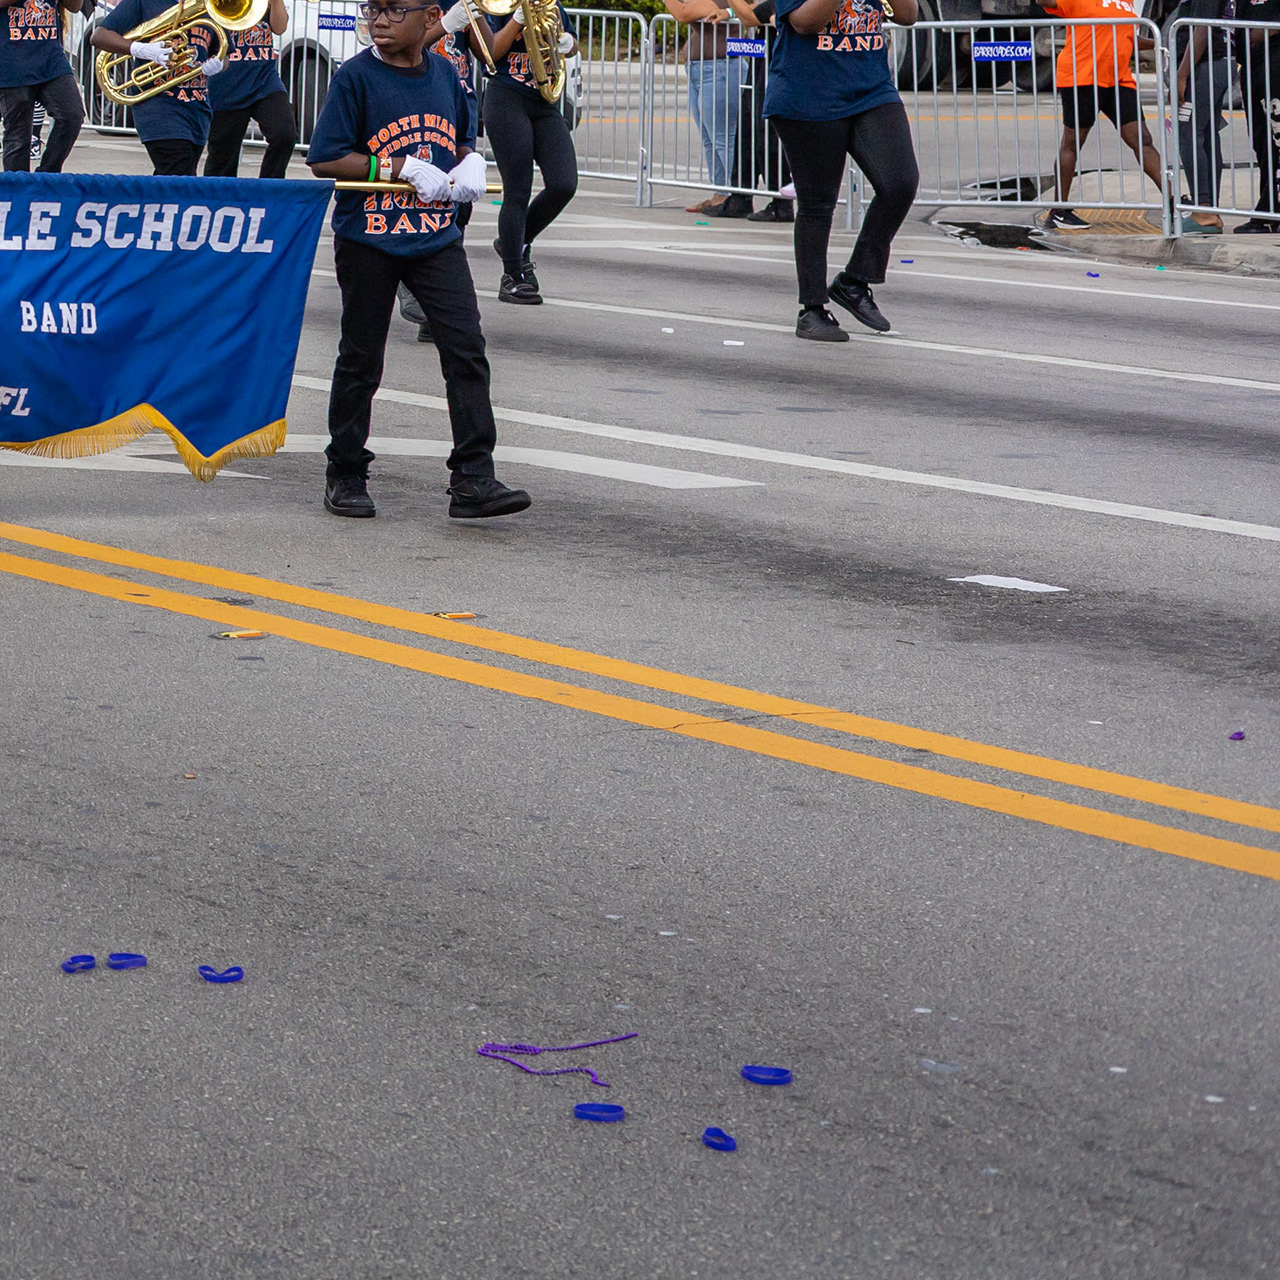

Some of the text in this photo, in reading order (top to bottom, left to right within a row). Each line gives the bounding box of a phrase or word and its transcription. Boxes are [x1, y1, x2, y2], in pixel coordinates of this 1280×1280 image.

[8, 6, 57, 28] TIGER
[229, 25, 273, 47] TIGER
[816, 35, 884, 51] BAND
[229, 47, 278, 62] BAN
[974, 45, 1032, 58] BARRICADES.COM
[367, 113, 457, 153] NORTH MIAM
[377, 132, 422, 159] MIDDLE
[70, 201, 274, 254] SCHOOL
[20, 300, 98, 334] BAND
